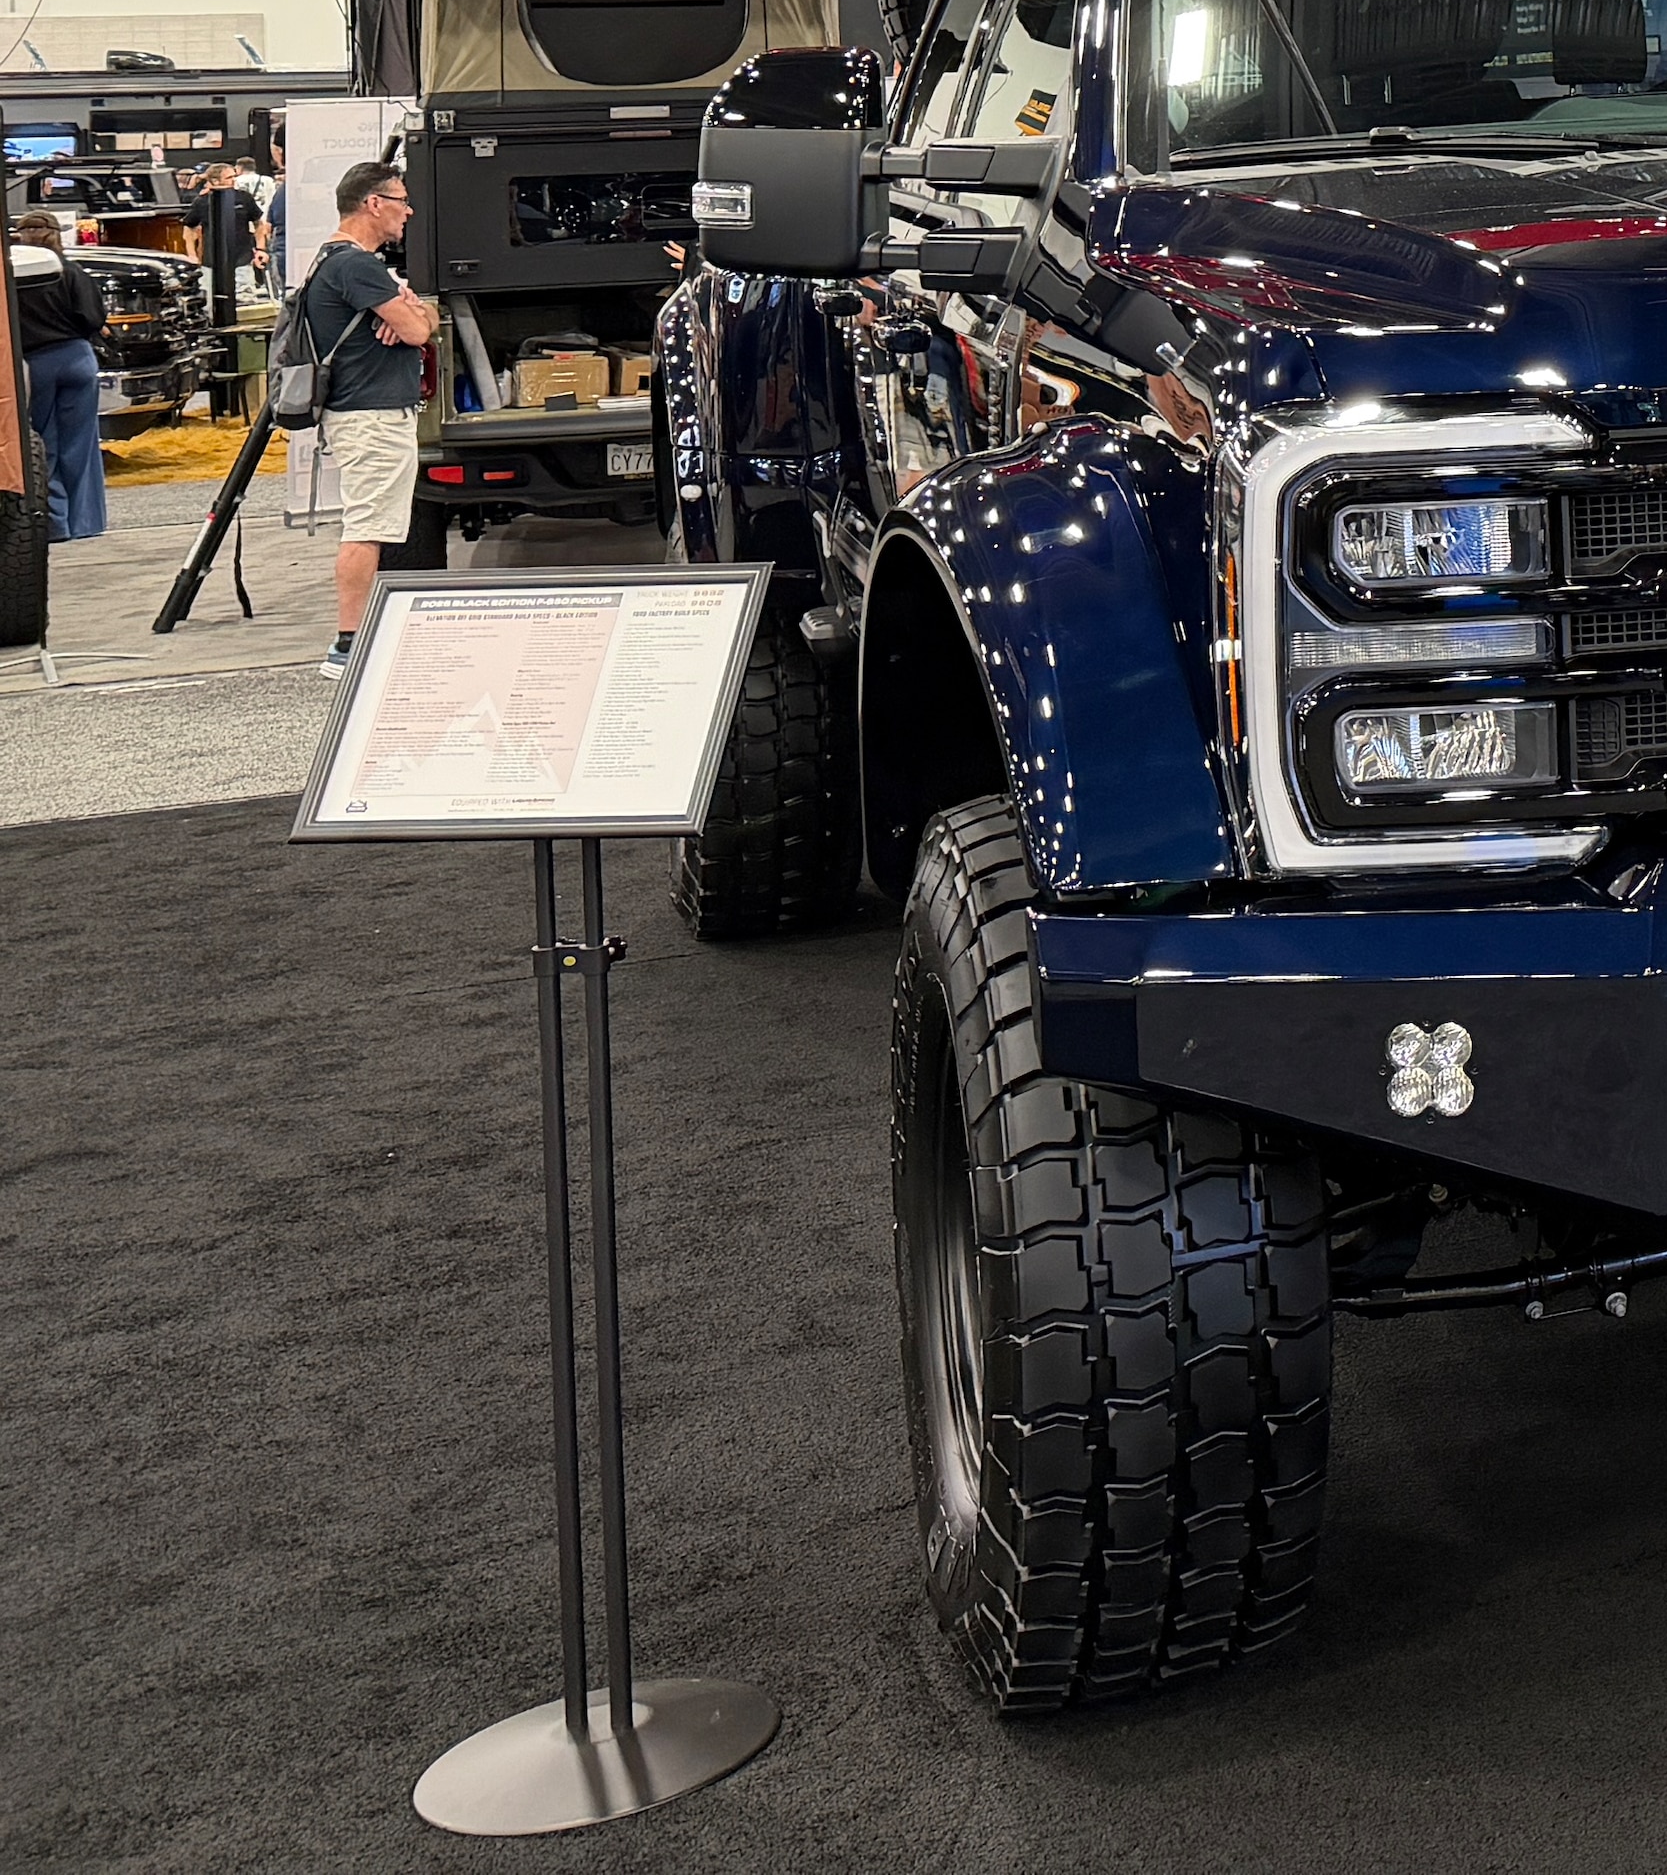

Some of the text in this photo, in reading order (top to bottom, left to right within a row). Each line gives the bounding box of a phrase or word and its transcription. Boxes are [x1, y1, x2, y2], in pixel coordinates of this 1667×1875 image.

[452, 599, 490, 608] BLACK
[491, 598, 535, 607] EDITION
[570, 596, 613, 605] PICKUP
